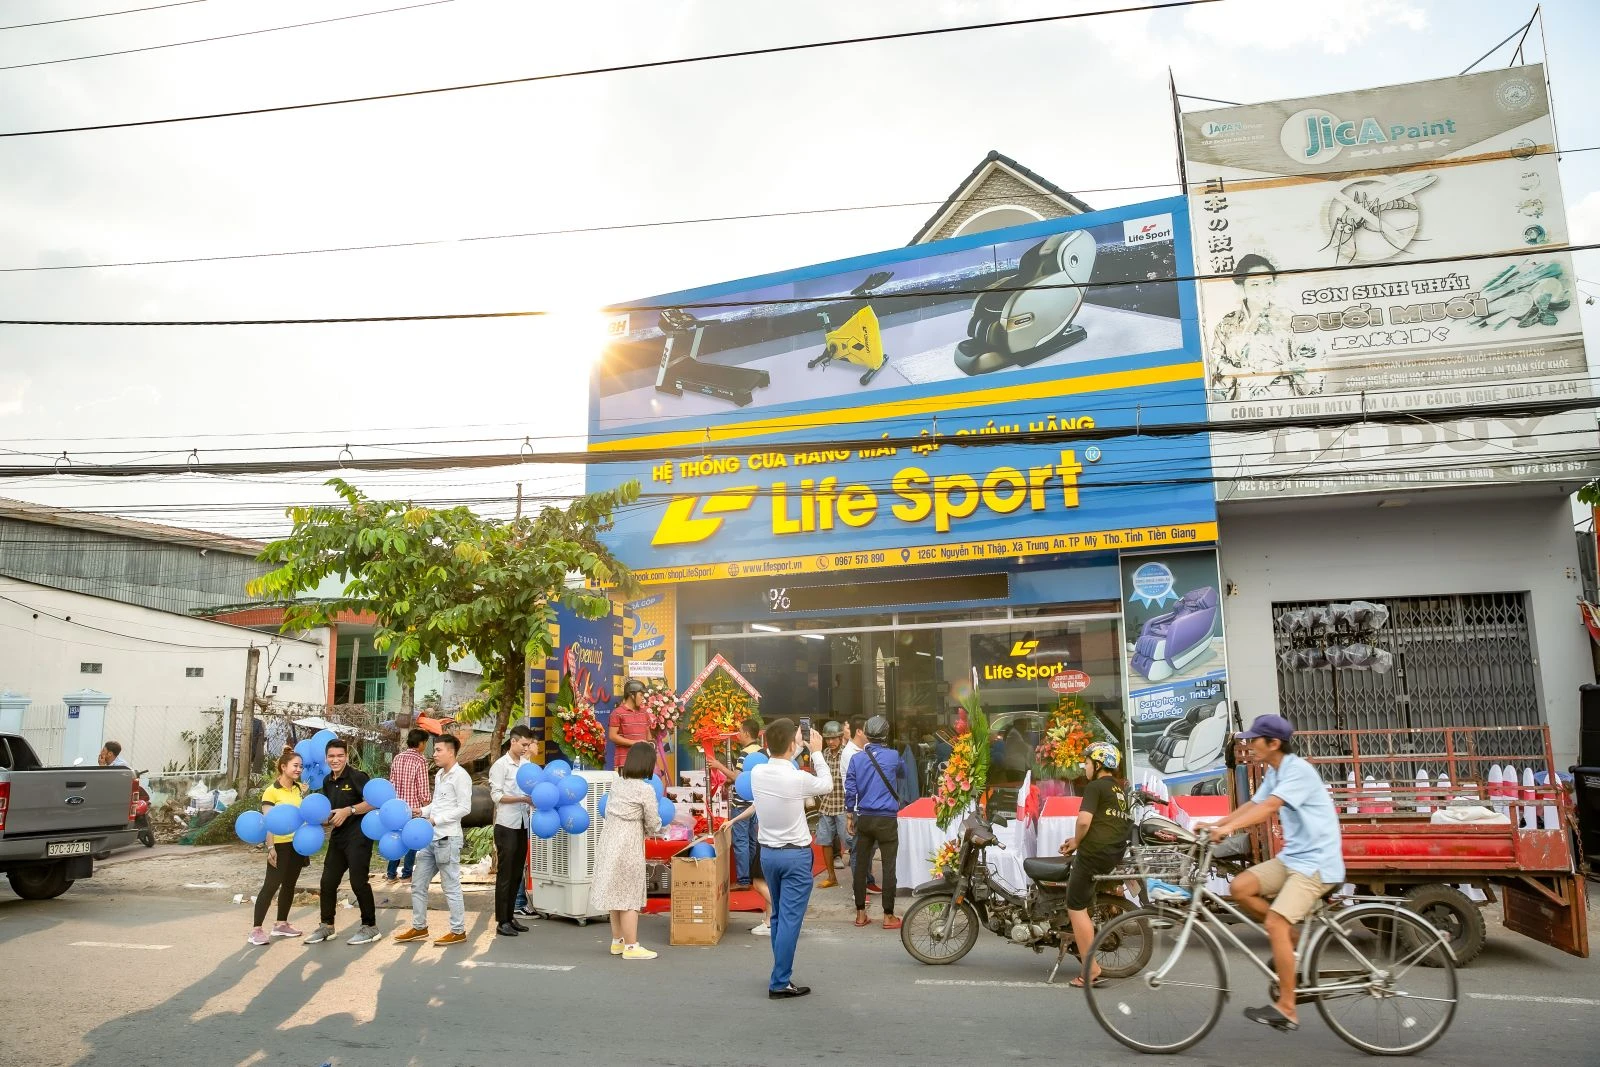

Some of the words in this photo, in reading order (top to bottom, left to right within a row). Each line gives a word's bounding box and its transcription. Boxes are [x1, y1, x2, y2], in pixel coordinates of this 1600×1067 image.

[1390, 119, 1457, 141] Paint
[1128, 234, 1145, 243] Life
[1145, 229, 1171, 241] Sport
[1302, 287, 1348, 304] SƠN
[1353, 281, 1409, 300] SINH
[1411, 273, 1471, 295] THÁI
[1231, 405, 1264, 419] CÔNG
[1269, 404, 1284, 417] TY
[1288, 403, 1320, 415] TNHH
[1324, 399, 1352, 413] MTV
[1382, 394, 1400, 408] VÀ
[1426, 390, 1462, 406] CÔNG
[652, 460, 674, 484] HỆ
[680, 455, 741, 478] THỐNG
[771, 475, 880, 535] Life
[891, 449, 1083, 533] Sport
[743, 560, 803, 574] www.lifesport.vn
[834, 555, 852, 567] 0967
[855, 554, 869, 565] 578
[871, 552, 885, 564] 890
[917, 548, 937, 560] 126C
[940, 544, 969, 559] Nguyễn
[972, 544, 985, 557] Thị
[1012, 541, 1023, 552] Xã
[1026, 539, 1049, 551] Trung
[1069, 537, 1080, 548] TP
[1084, 535, 1098, 548] Mỹ
[1148, 527, 1167, 541] Tiền
[1171, 528, 1196, 540] Giang
[984, 664, 1014, 680] Life
[1016, 661, 1064, 681] Sport
[1140, 699, 1162, 709] Sang
